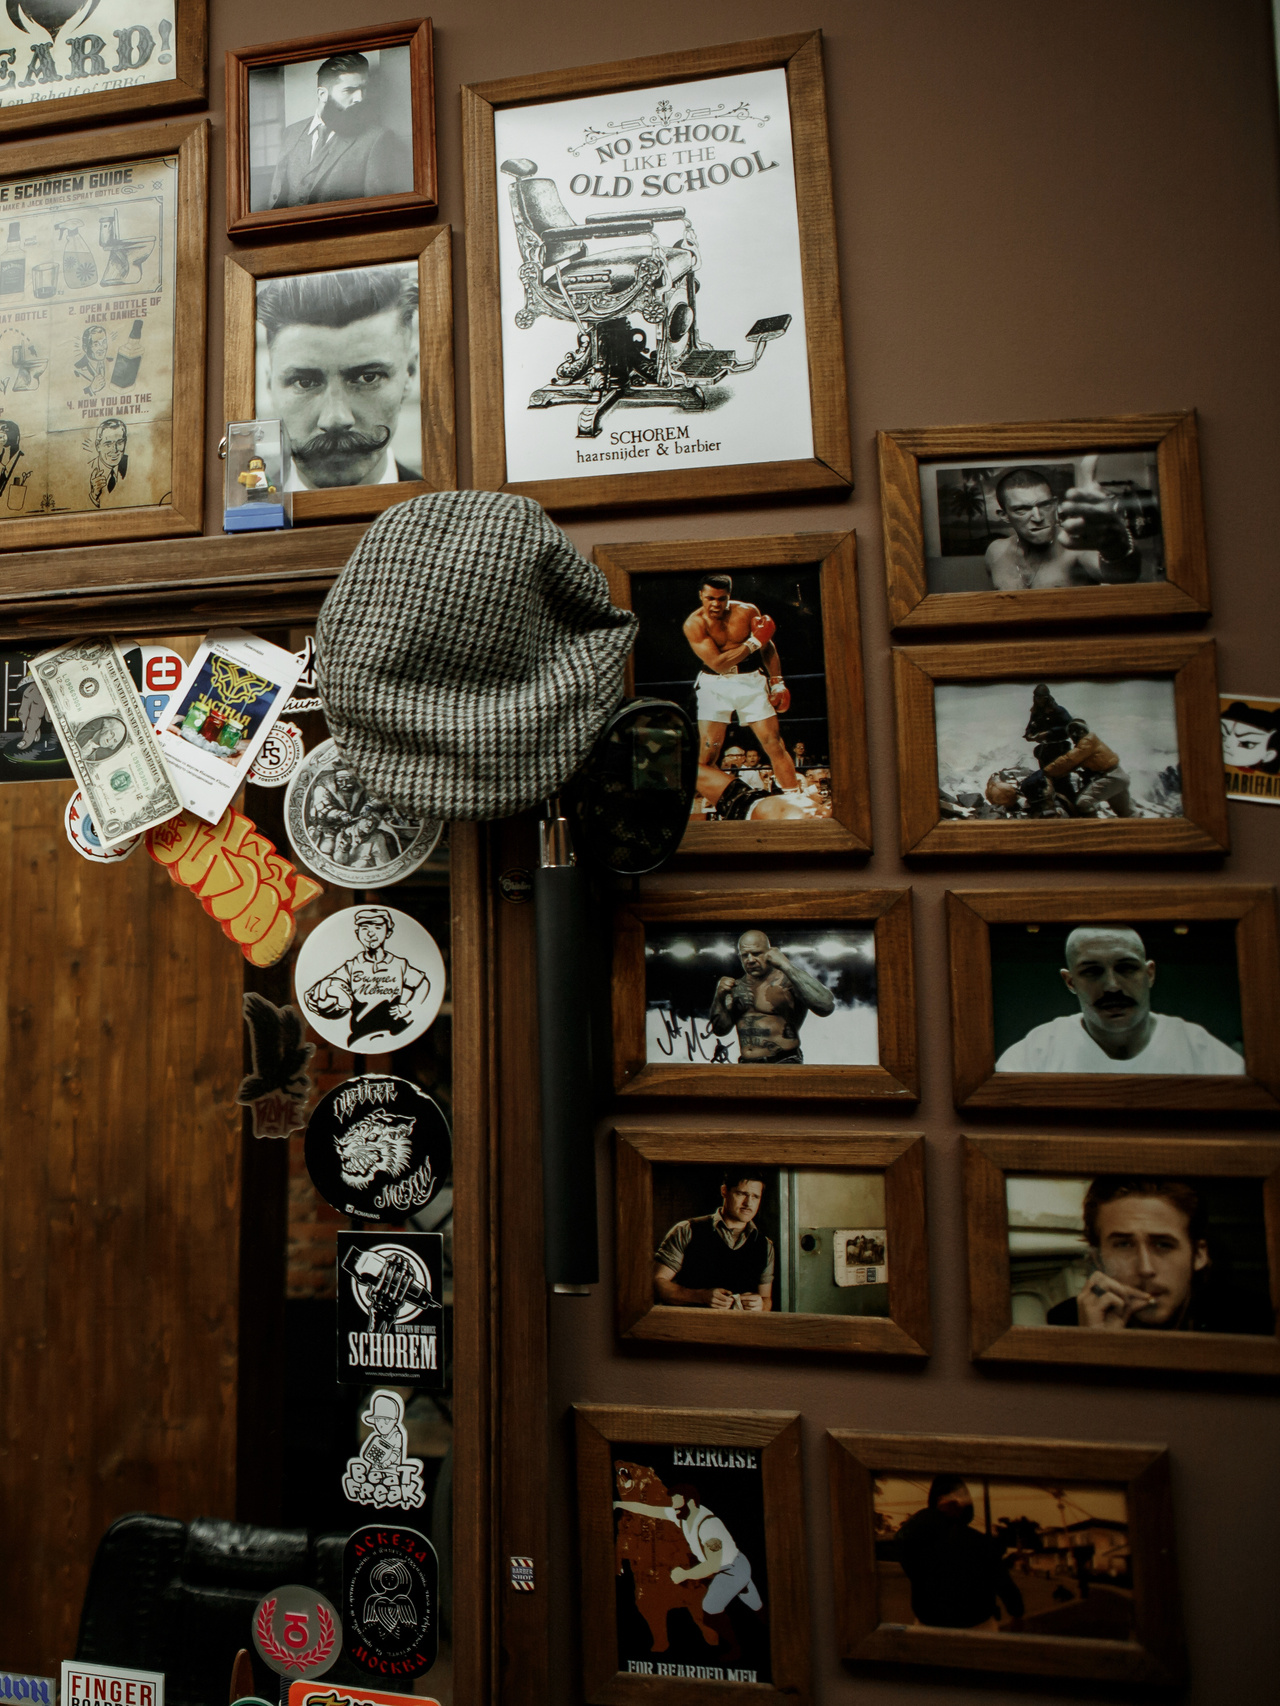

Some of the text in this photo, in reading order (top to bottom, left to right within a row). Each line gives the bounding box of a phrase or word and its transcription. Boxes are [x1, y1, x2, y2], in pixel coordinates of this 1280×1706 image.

[595, 123, 746, 165] NO SCHOOL
[622, 146, 716, 172] LIKE THE
[570, 150, 780, 198] OLD SCHOOL
[14, 176, 84, 201] SCHOREM
[89, 168, 133, 189] GUIDE
[2, 203, 20, 212] MAKE
[27, 200, 43, 209] JACK
[44, 195, 72, 206] DANIELS
[72, 192, 93, 202] SPRAY
[95, 188, 120, 198] BOTTLE
[68, 296, 162, 315] 2. OPEN A BOTTLE OF
[15, 310, 48, 323] BOTTLE
[85, 308, 147, 324] JACK DANIELS
[67, 393, 152, 410] 4. NOW YOU DO THE
[82, 406, 115, 419] FUCKIN
[610, 425, 690, 445] SCHOREM
[577, 439, 721, 463] haarsnijder & barbier
[81, 664, 90, 672] 12
[55, 676, 63, 684] 12
[84, 682, 95, 693] L
[195, 692, 253, 728] ЧАСТНАЯ
[104, 659, 165, 784] THE UNITED STATES OF AMERICA
[261, 741, 281, 766] FS
[258, 775, 279, 783] FOREVER
[280, 762, 298, 780] PREMIUM
[135, 792, 145, 801] 12
[108, 806, 117, 815] 12
[353, 970, 398, 987] Вымпел
[353, 984, 400, 998] Метеор
[395, 1325, 414, 1334] WEAPON
[414, 1325, 420, 1333] OF
[348, 1331, 438, 1370] SCHOREM
[673, 1447, 758, 1469] EXERCISE
[354, 1532, 428, 1563] АСКЕЗА
[512, 1567, 533, 1575] BARBER
[351, 1646, 429, 1675] МОСКВА
[627, 1660, 758, 1684] FOR BEARDED MEN
[71, 1675, 153, 1706] FINGER
